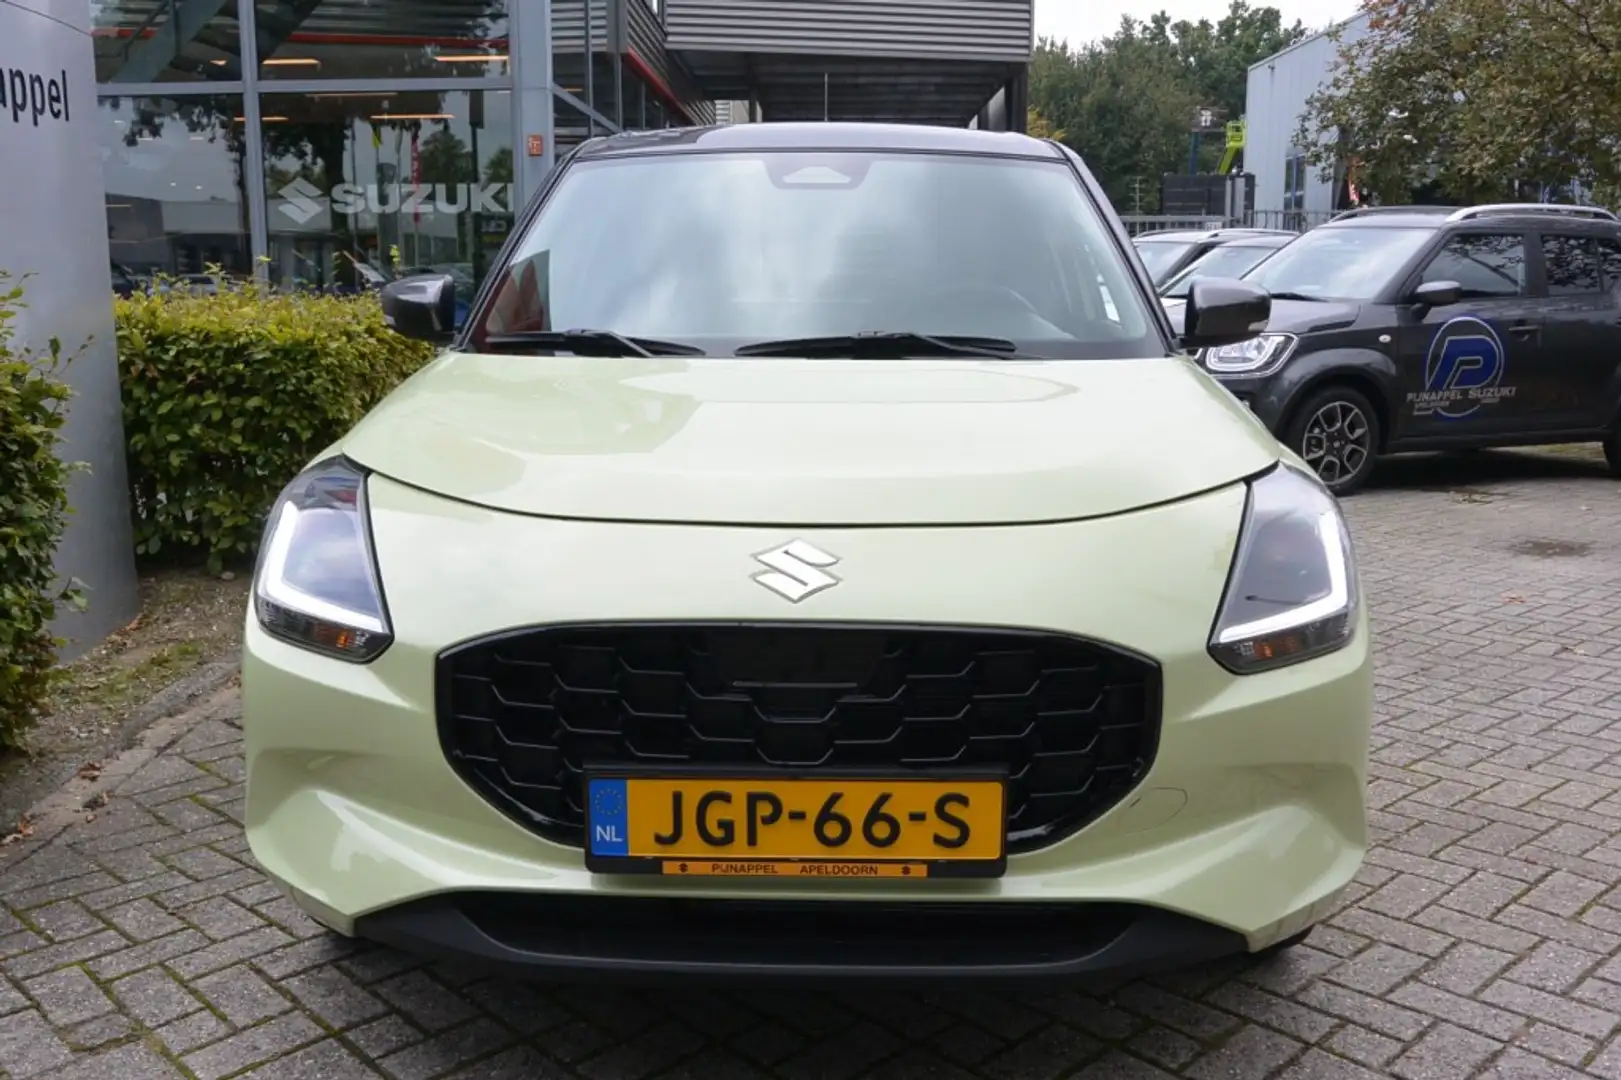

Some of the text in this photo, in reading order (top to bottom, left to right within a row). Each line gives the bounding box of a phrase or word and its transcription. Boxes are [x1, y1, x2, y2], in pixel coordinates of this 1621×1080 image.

[331, 182, 514, 214] SUZUKI
[1468, 386, 1516, 399] SUZUKI
[653, 790, 971, 848] JGP-66-S
[596, 823, 623, 842] NL
[800, 864, 878, 876] APELDOORN
